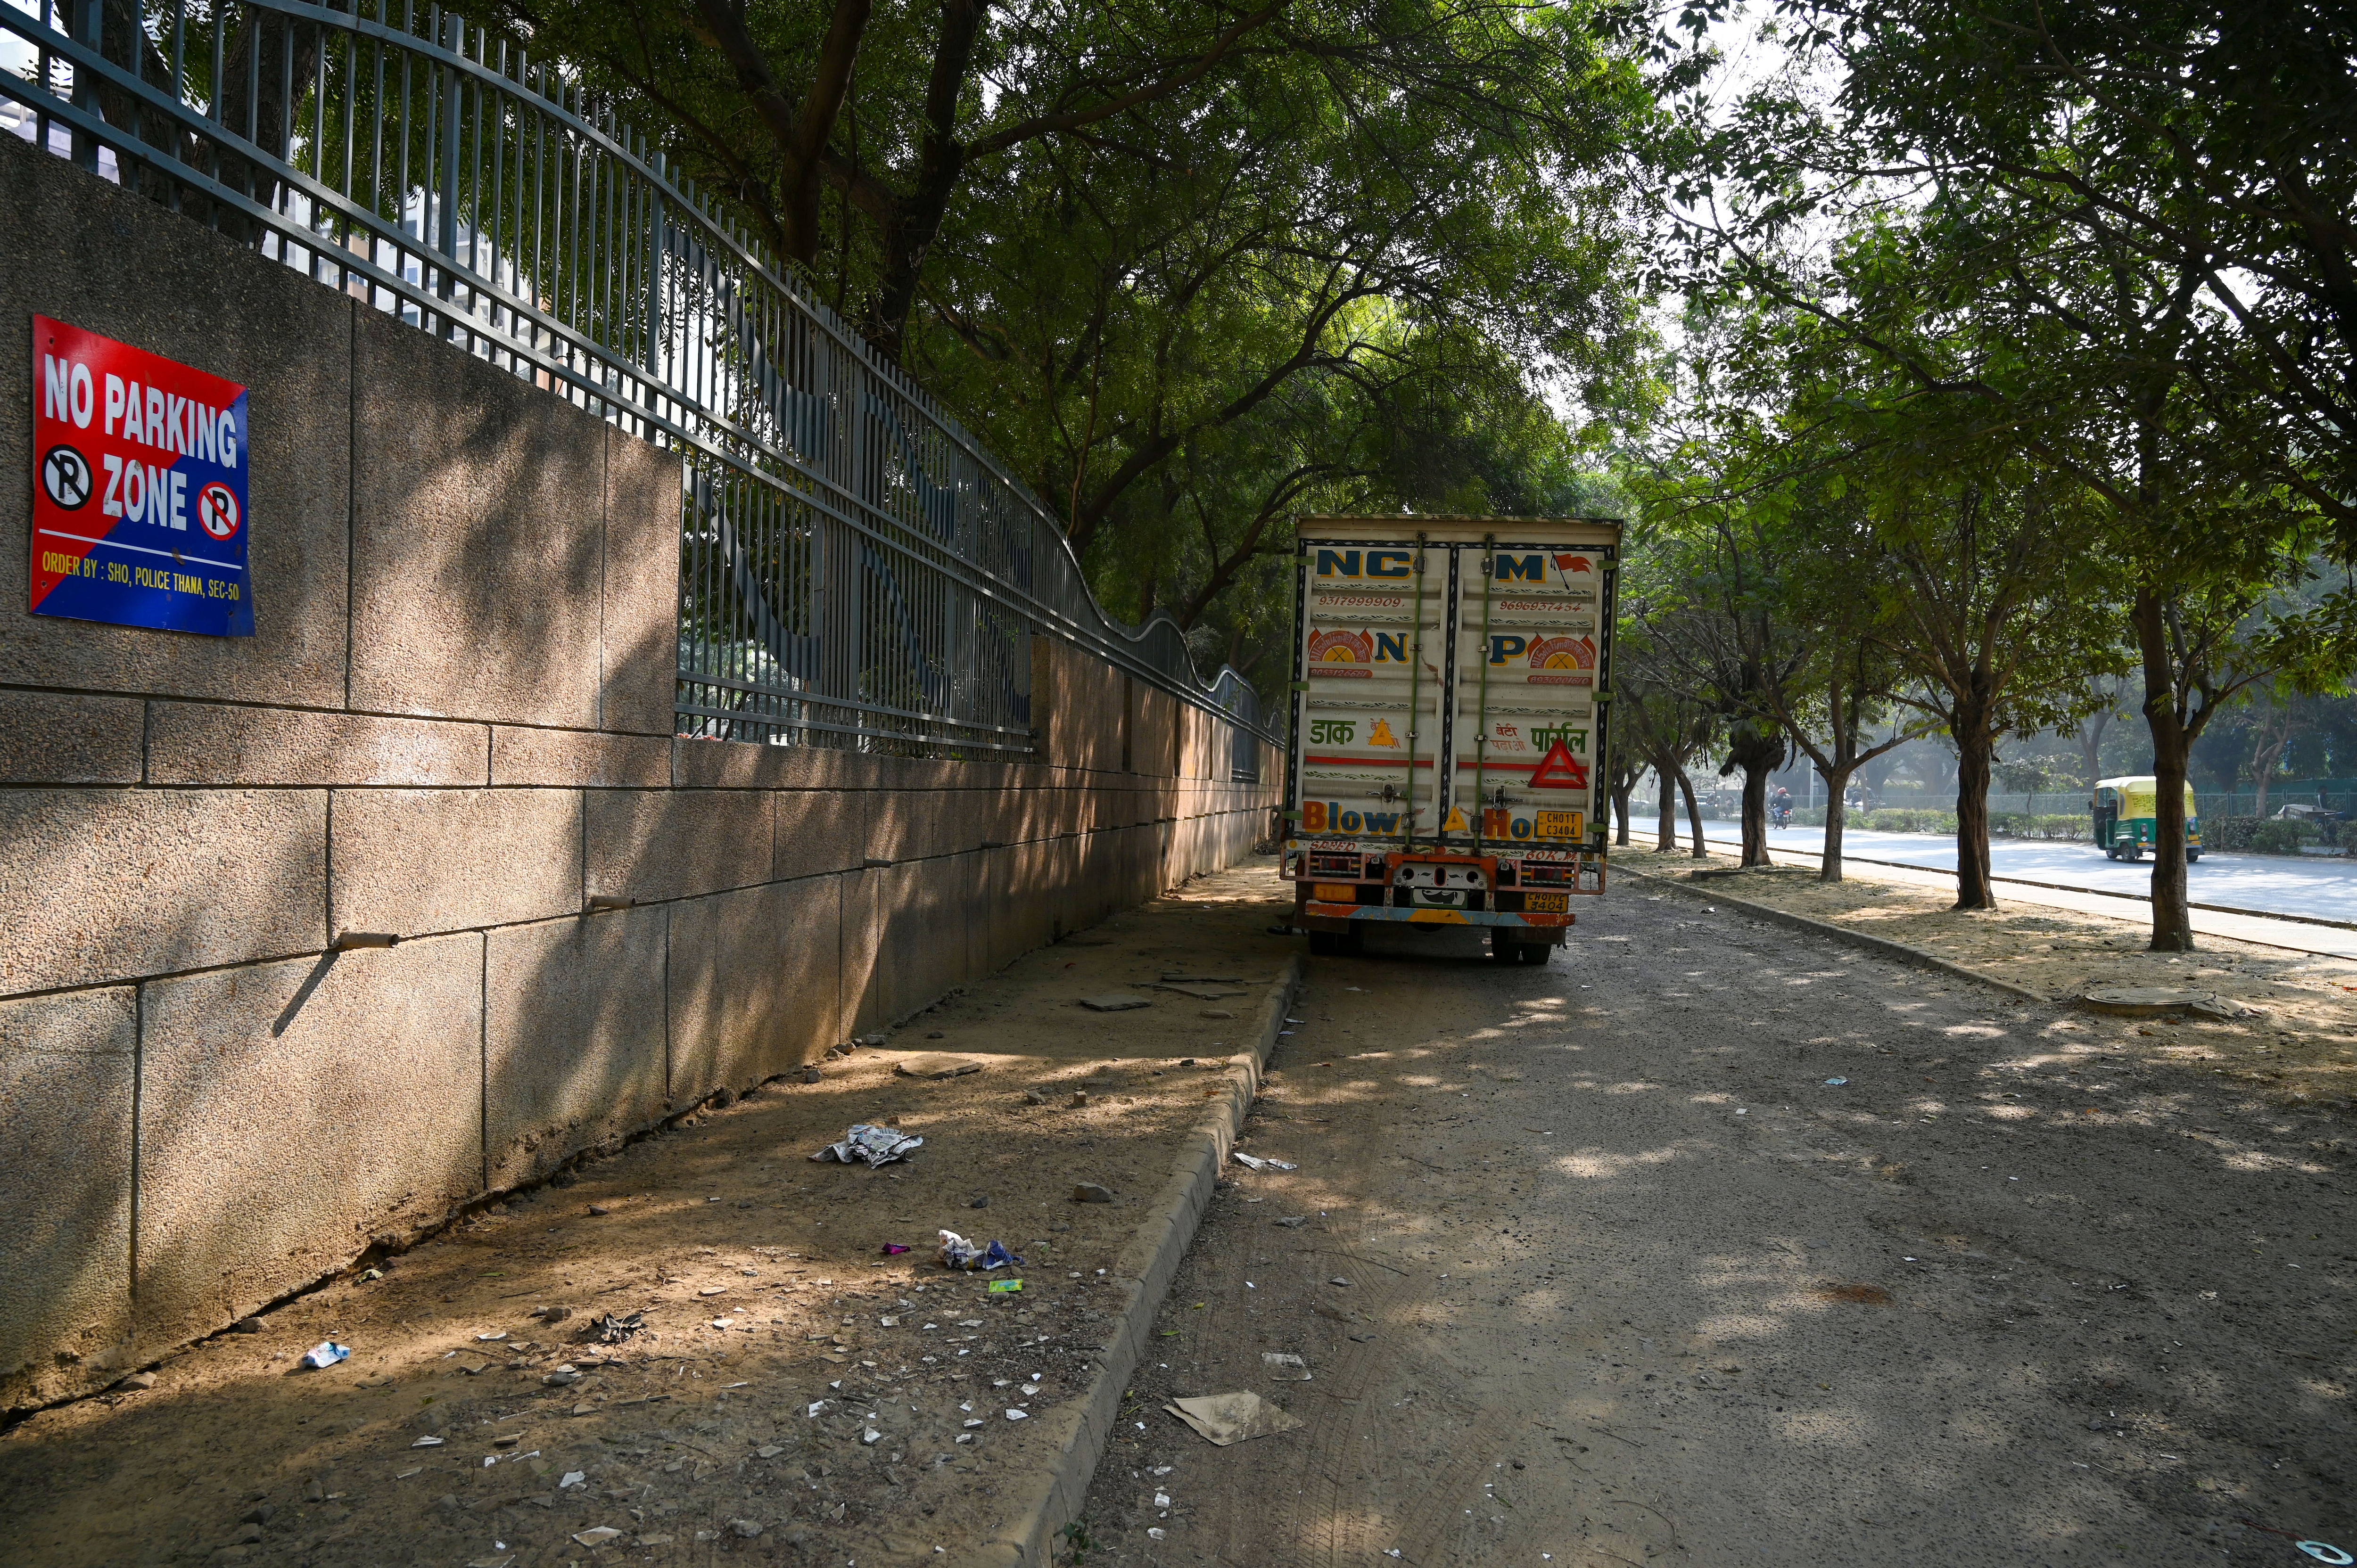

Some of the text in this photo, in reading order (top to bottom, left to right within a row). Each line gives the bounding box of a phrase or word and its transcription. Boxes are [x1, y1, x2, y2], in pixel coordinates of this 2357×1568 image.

[45, 354, 237, 468] NO PARKING
[103, 454, 187, 531] ZONE
[42, 551, 80, 576] ORDER
[83, 559, 97, 577] BY
[108, 562, 132, 587] SHO,
[135, 567, 170, 590] POLICE
[173, 573, 206, 599] THANA,
[208, 582, 239, 601] SEC-50
[1317, 550, 1413, 580] NC
[1495, 555, 1546, 583] M
[1375, 632, 1409, 664] N
[1489, 635, 1528, 666] P
[1536, 639, 1565, 659] Solution
[1310, 720, 1356, 744] डाक
[1495, 723, 1517, 737] बेटी
[1302, 801, 1402, 836] Blow
[1547, 813, 1575, 823] CH01T
[1547, 825, 1575, 836] C3404
[1309, 841, 1356, 852] SPEED
[1530, 901, 1563, 911] 3404
